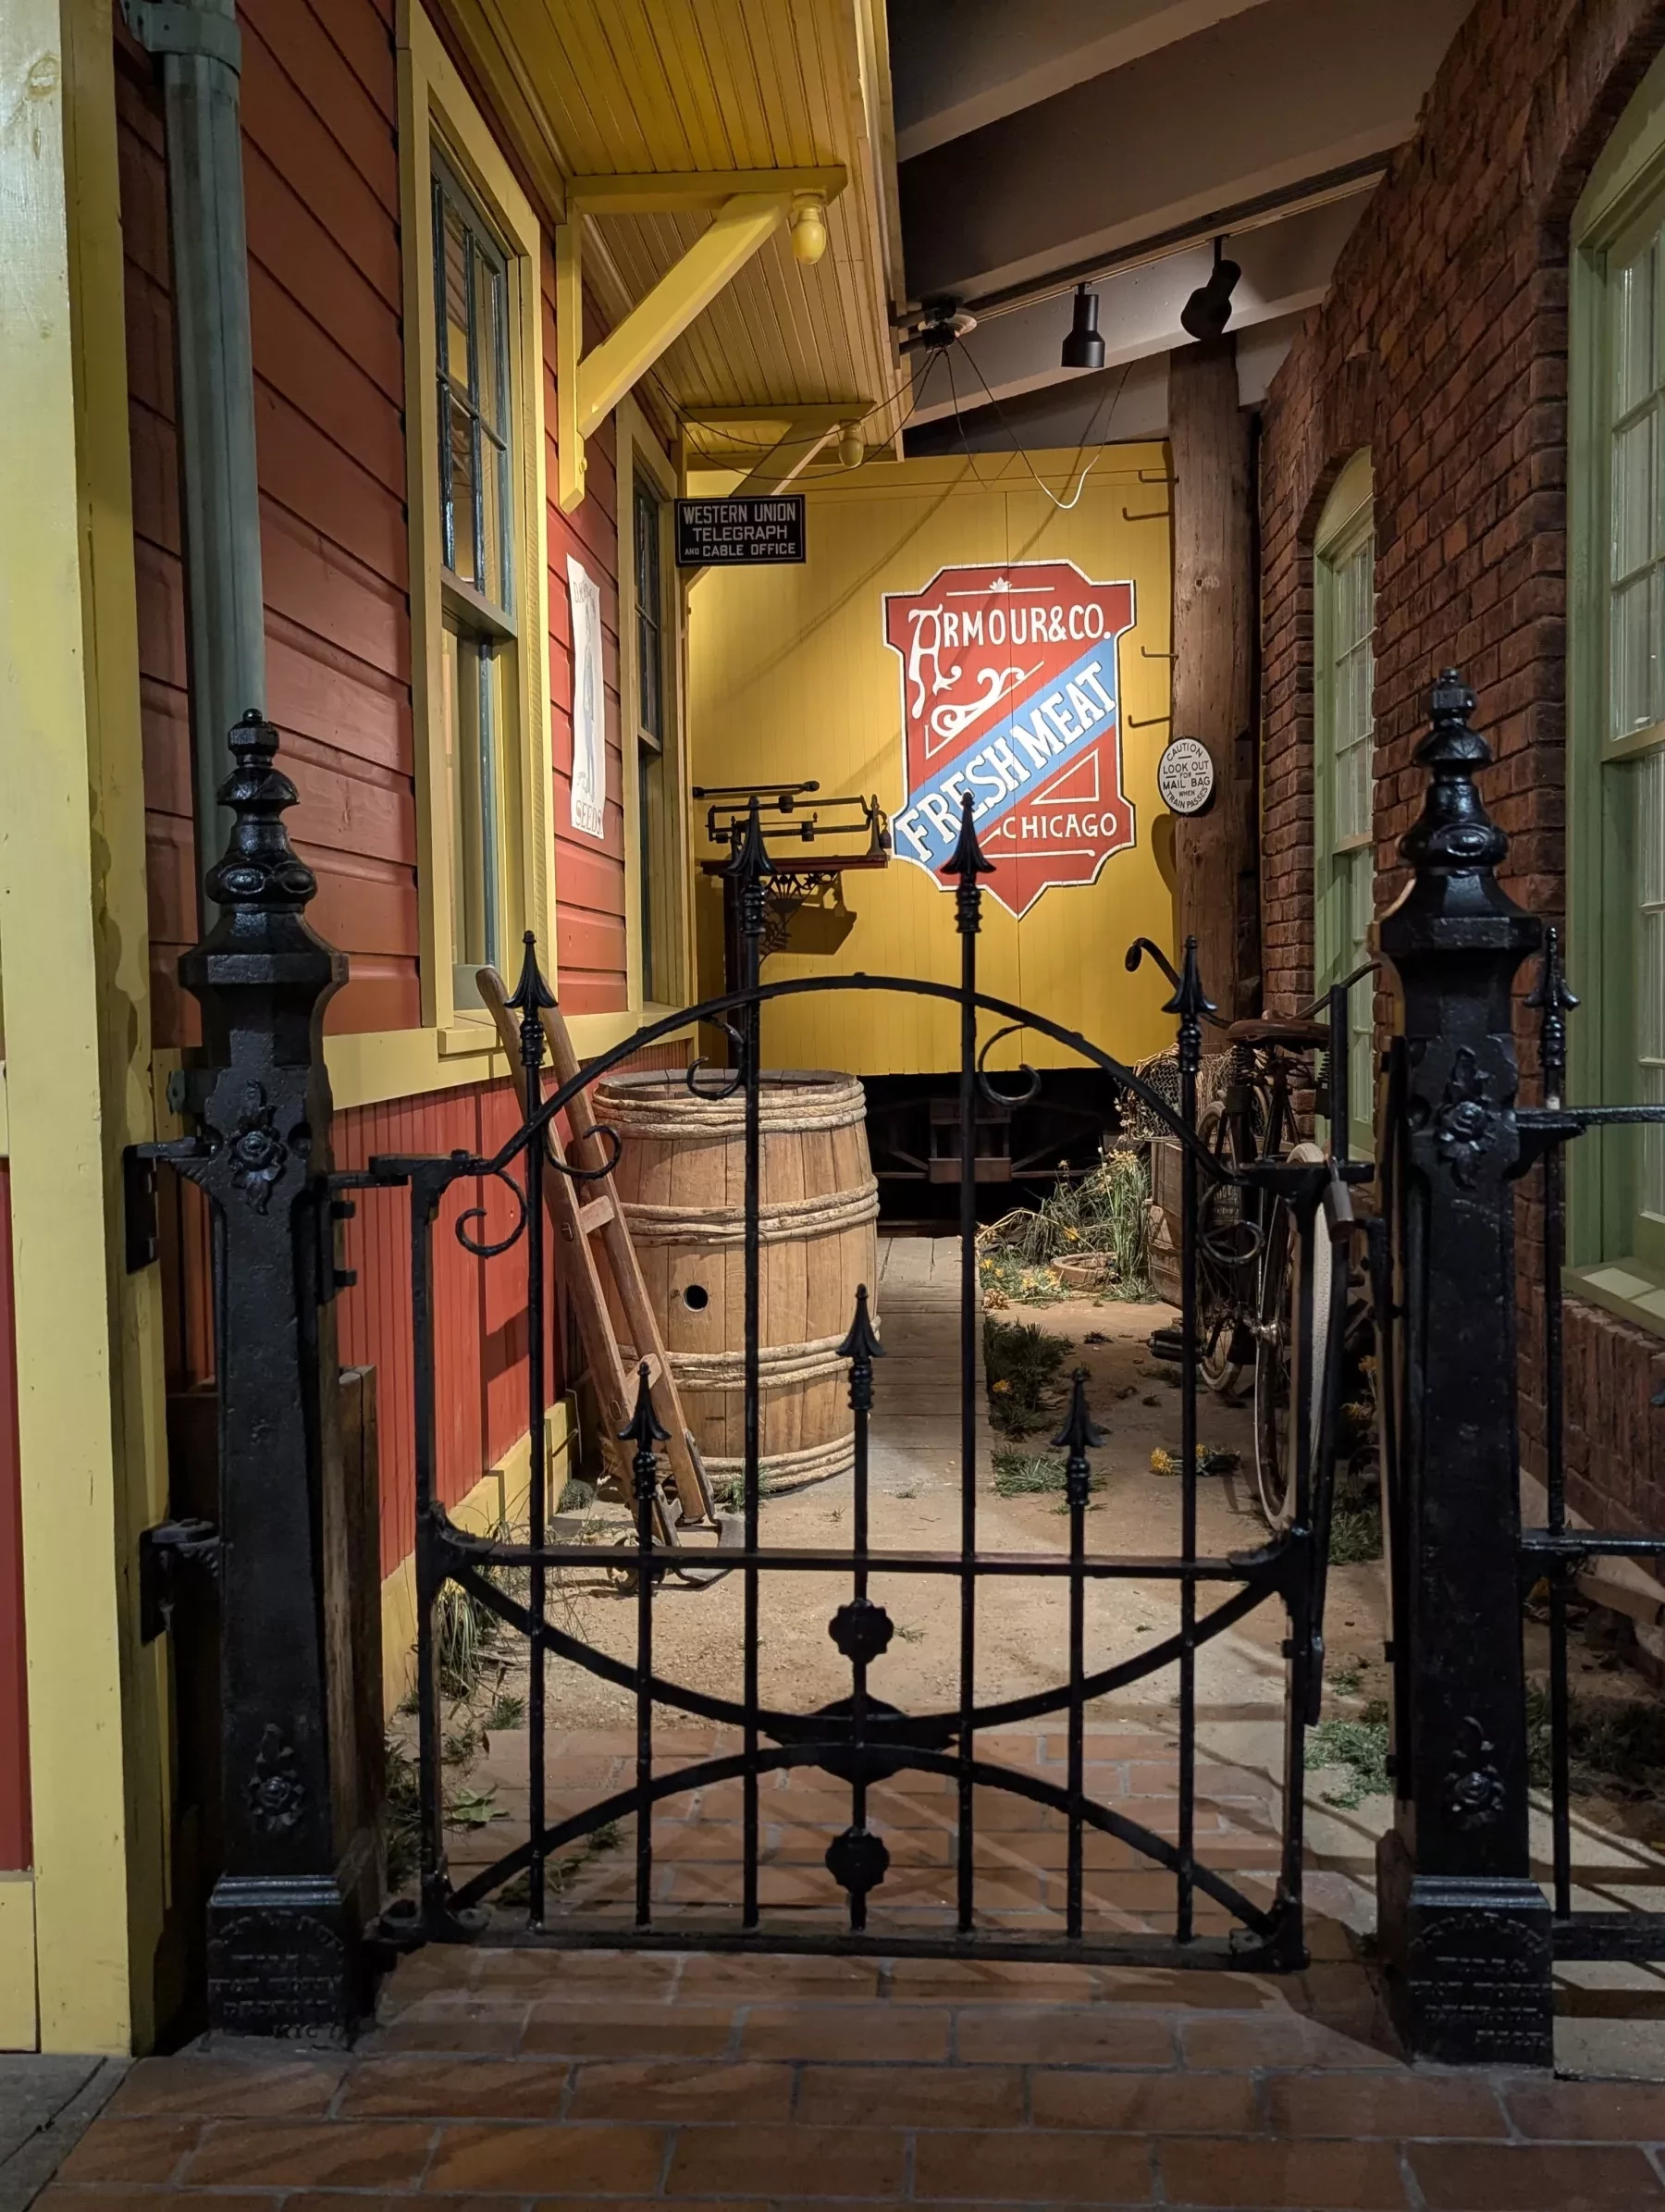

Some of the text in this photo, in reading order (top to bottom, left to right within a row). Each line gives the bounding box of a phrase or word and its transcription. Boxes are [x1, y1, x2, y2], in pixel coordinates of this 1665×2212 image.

[683, 502, 796, 525] WESTERN UNION
[692, 525, 788, 542] TELEGRAPH
[702, 544, 744, 557] CABLE
[750, 543, 796, 555] OFFICE
[894, 661, 1117, 863] FRESH MEAT
[1166, 742, 1203, 761] CAUTION
[1163, 760, 1209, 774] LOOK OUT
[1163, 776, 1210, 790] MAIL BAG
[1166, 786, 1208, 809] TRAIN PASSES
[575, 799, 601, 834] SEEDS
[1002, 812, 1117, 839] CHICAGO
